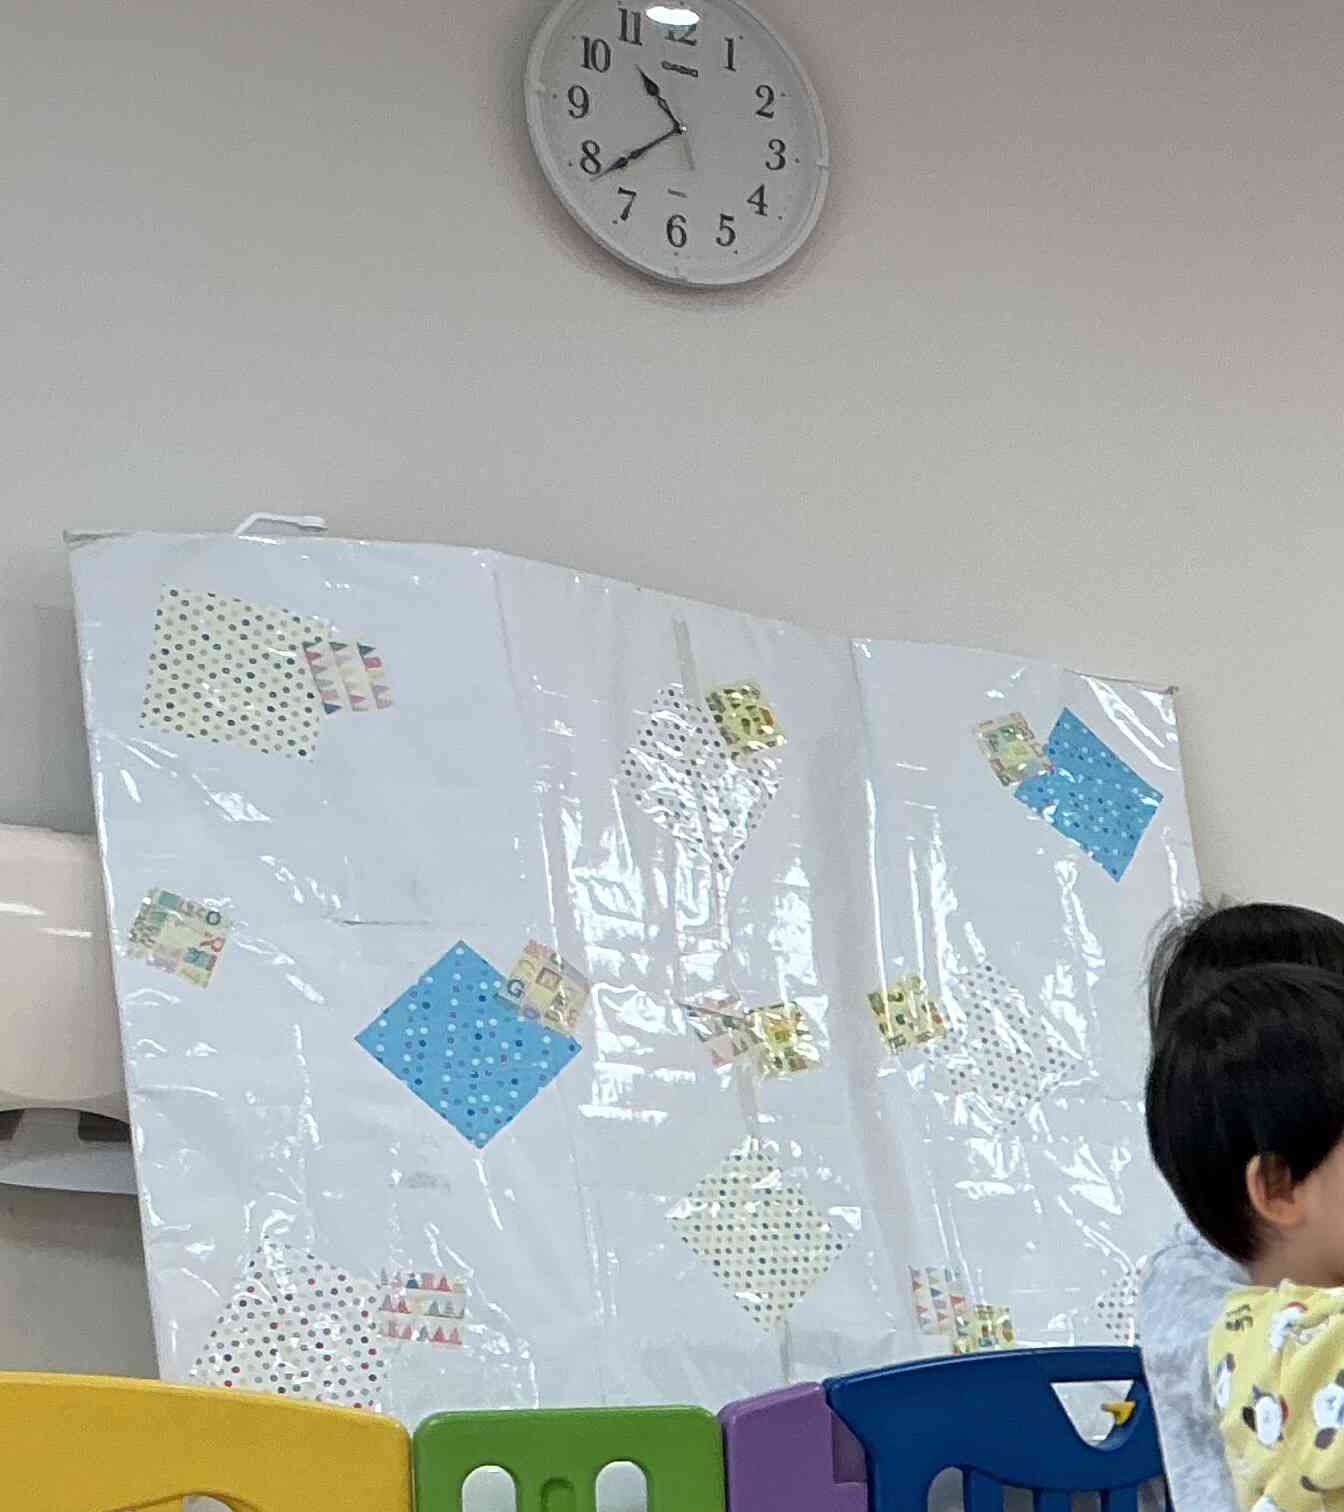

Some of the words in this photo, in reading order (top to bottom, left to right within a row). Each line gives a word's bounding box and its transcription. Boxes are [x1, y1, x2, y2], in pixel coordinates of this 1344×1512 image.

[617, 7, 643, 46] 11
[581, 35, 611, 73] 10
[723, 37, 737, 71] 1
[567, 85, 590, 118] 9
[755, 85, 775, 118] 2
[580, 140, 601, 175] 8
[765, 139, 787, 171] 3
[616, 187, 637, 221] 7
[746, 184, 768, 216] 4
[666, 214, 688, 248] 6
[715, 213, 736, 247] 5
